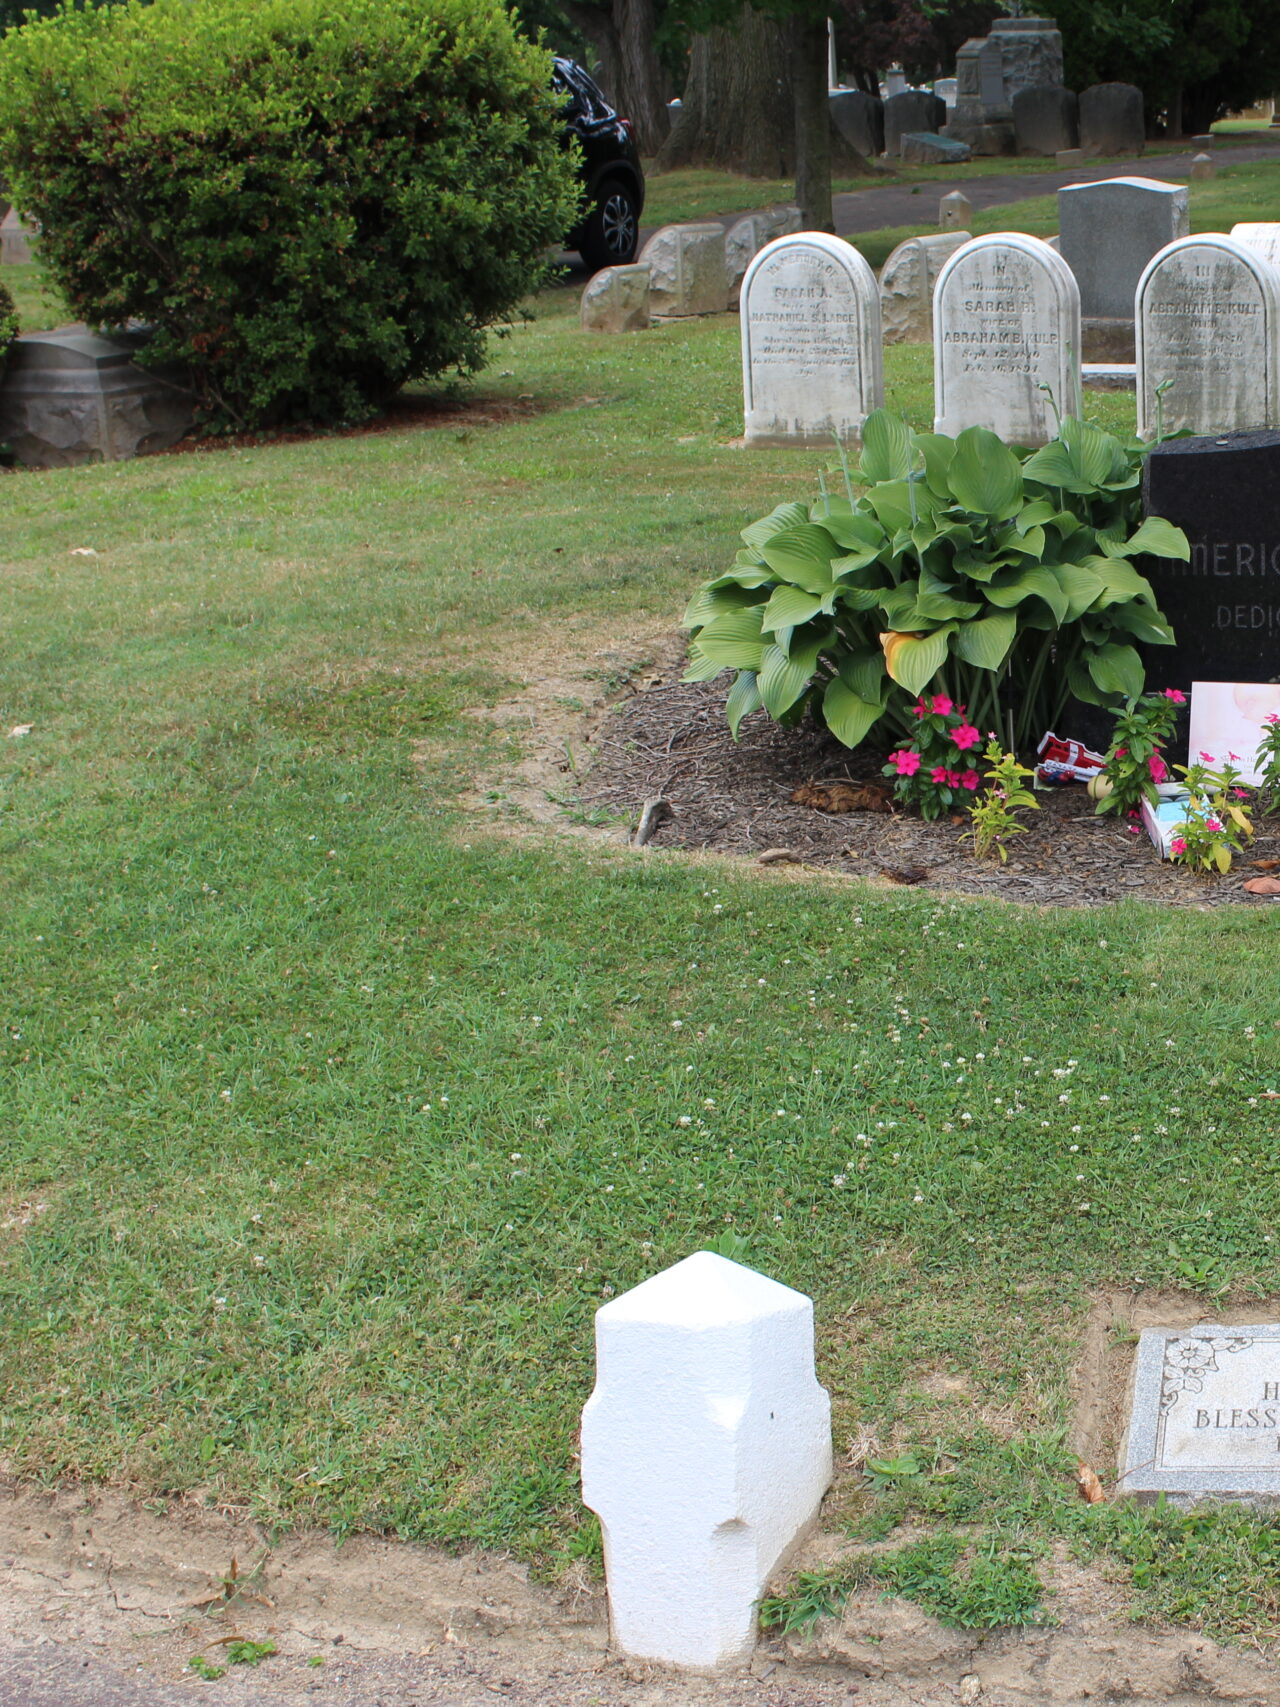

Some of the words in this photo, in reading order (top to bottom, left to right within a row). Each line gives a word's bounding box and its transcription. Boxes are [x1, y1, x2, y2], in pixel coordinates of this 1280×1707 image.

[992, 265, 1006, 276] IN
[964, 300, 1016, 313] SARAH
[1149, 302, 1214, 314] ABRAHAM
[944, 331, 1010, 344] ABRAHAM
[1194, 1408, 1277, 1429] BLESS
